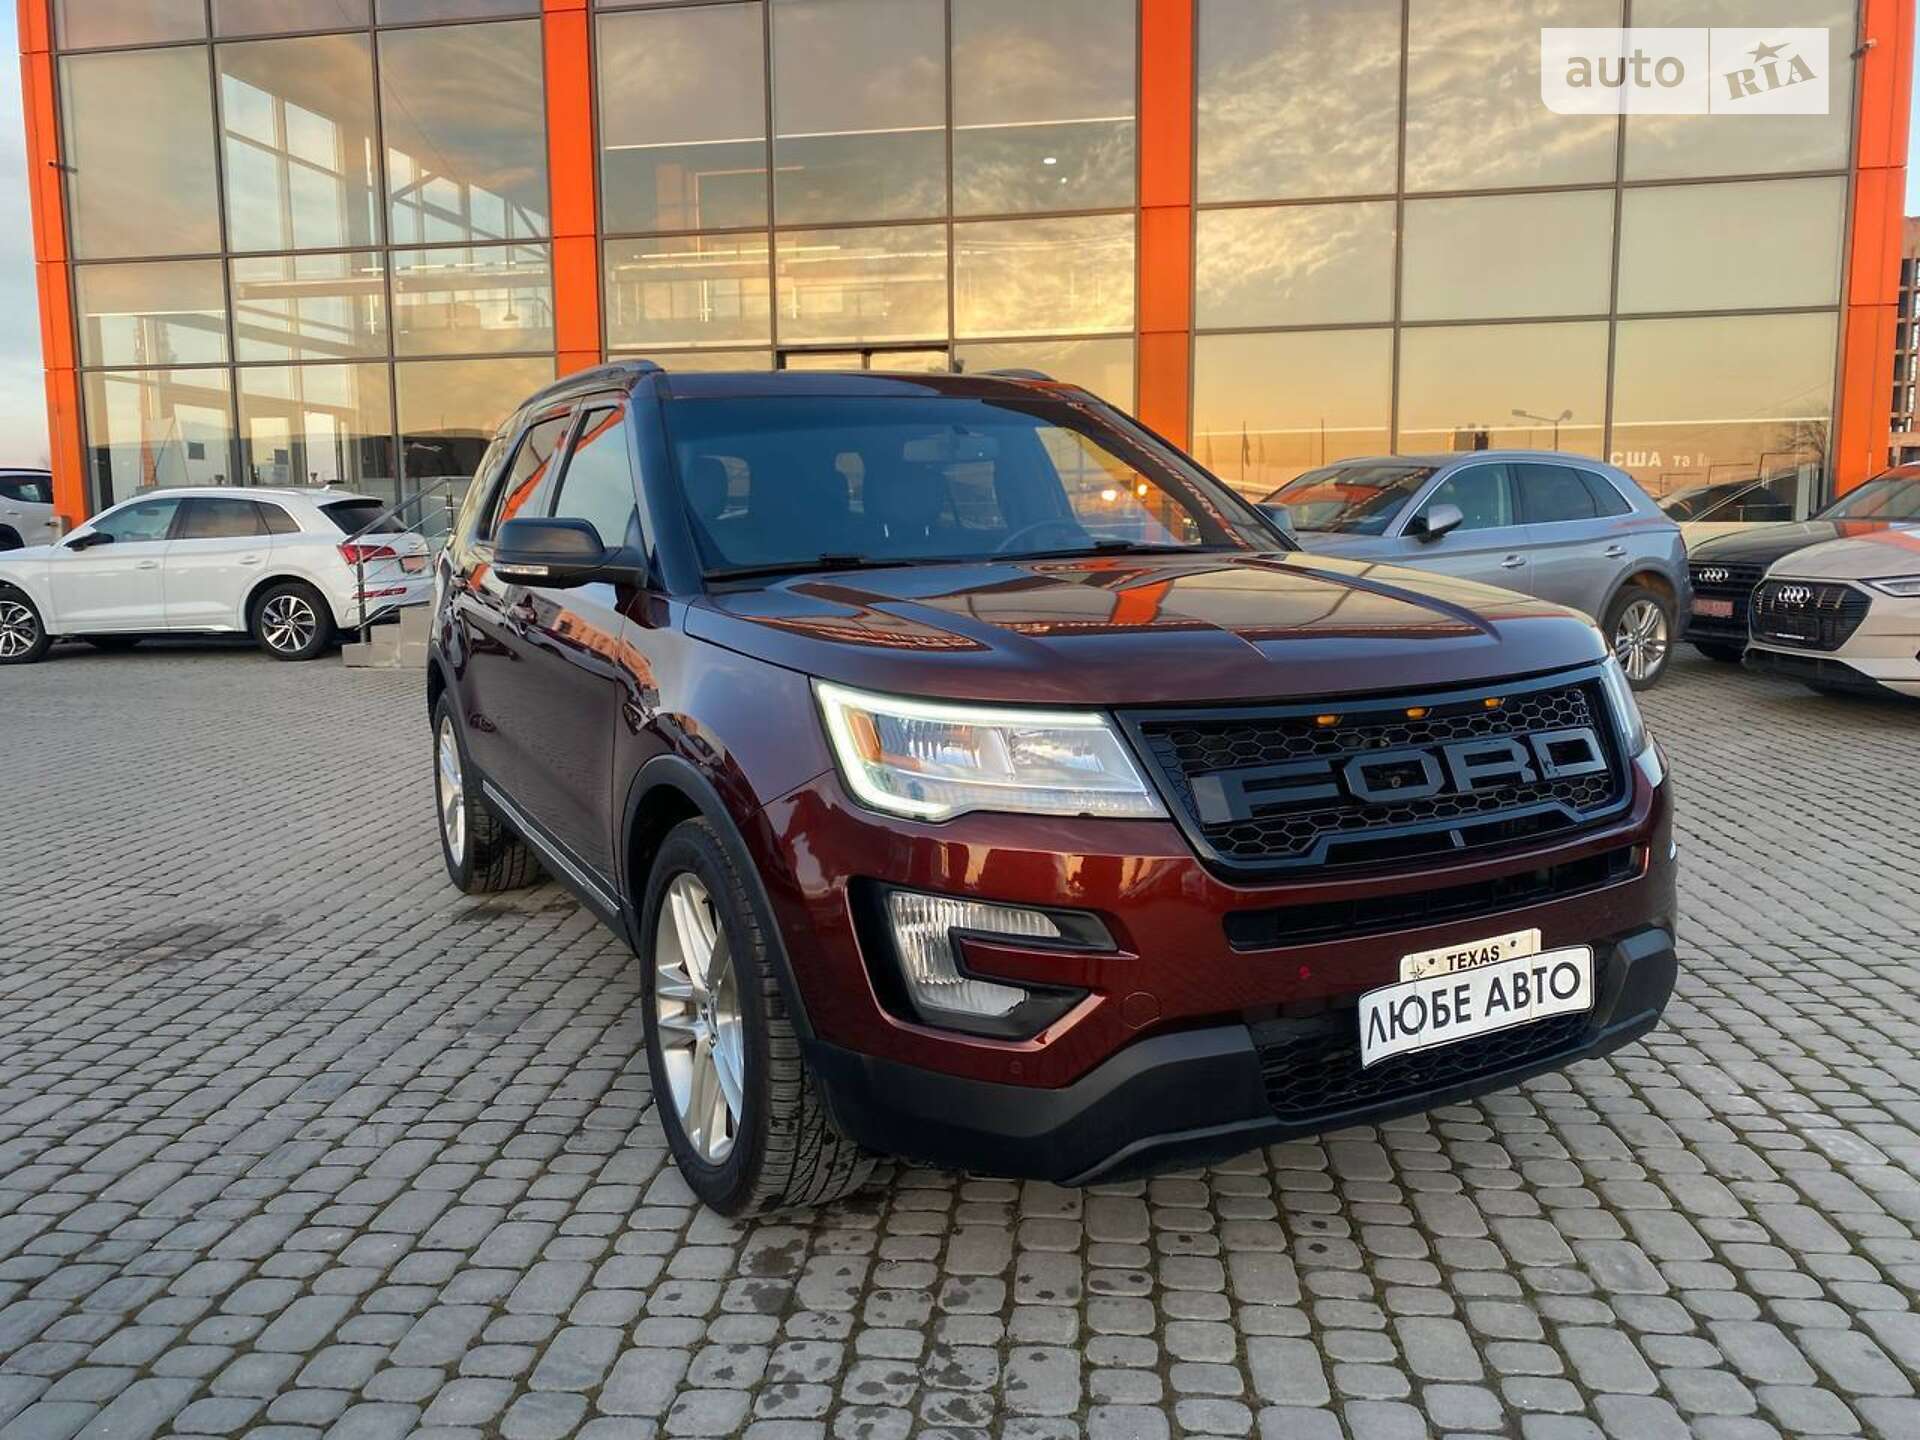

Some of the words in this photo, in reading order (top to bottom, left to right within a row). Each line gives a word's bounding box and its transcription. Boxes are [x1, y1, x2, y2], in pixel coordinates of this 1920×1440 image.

[1610, 451, 1662, 468] США
[1190, 728, 1608, 825] FORD
[1447, 945, 1500, 972] TEXAS
[1367, 983, 1473, 1050] ЛЮБЕ
[1484, 960, 1581, 1018] АВТО
